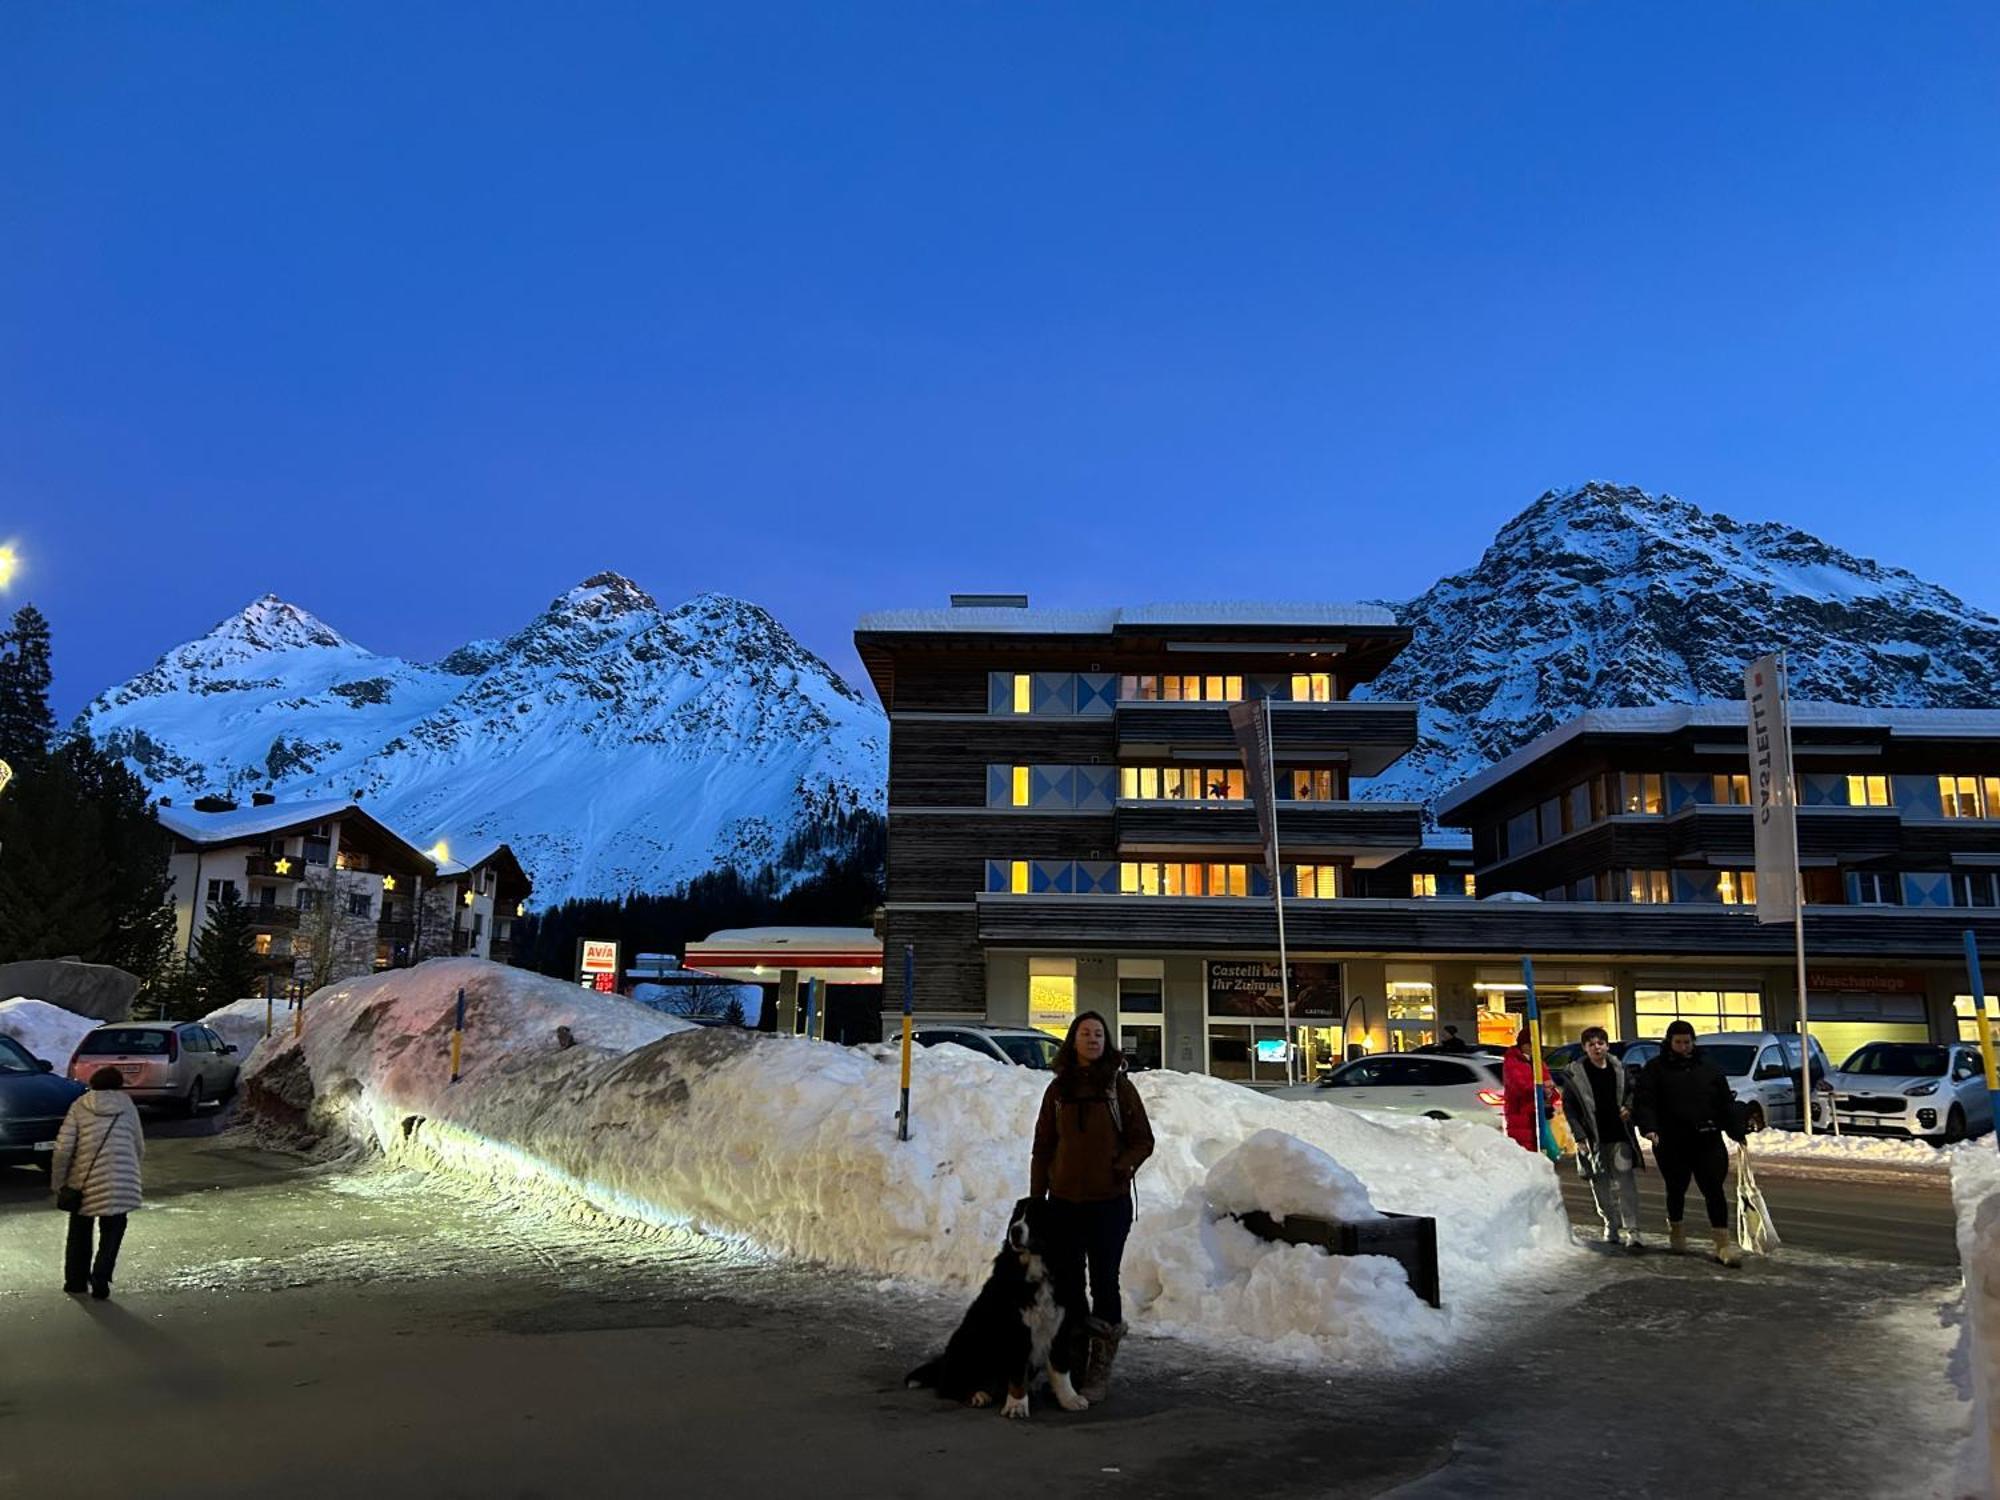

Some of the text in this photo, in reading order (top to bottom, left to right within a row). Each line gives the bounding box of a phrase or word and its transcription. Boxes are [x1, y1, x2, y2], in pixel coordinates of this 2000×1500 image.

[587, 946, 613, 958] AVIA
[1212, 965, 1260, 977] Castelli
[1212, 979, 1283, 991] Ihr Zuhaus
[1809, 974, 1905, 991] Waschanlage
